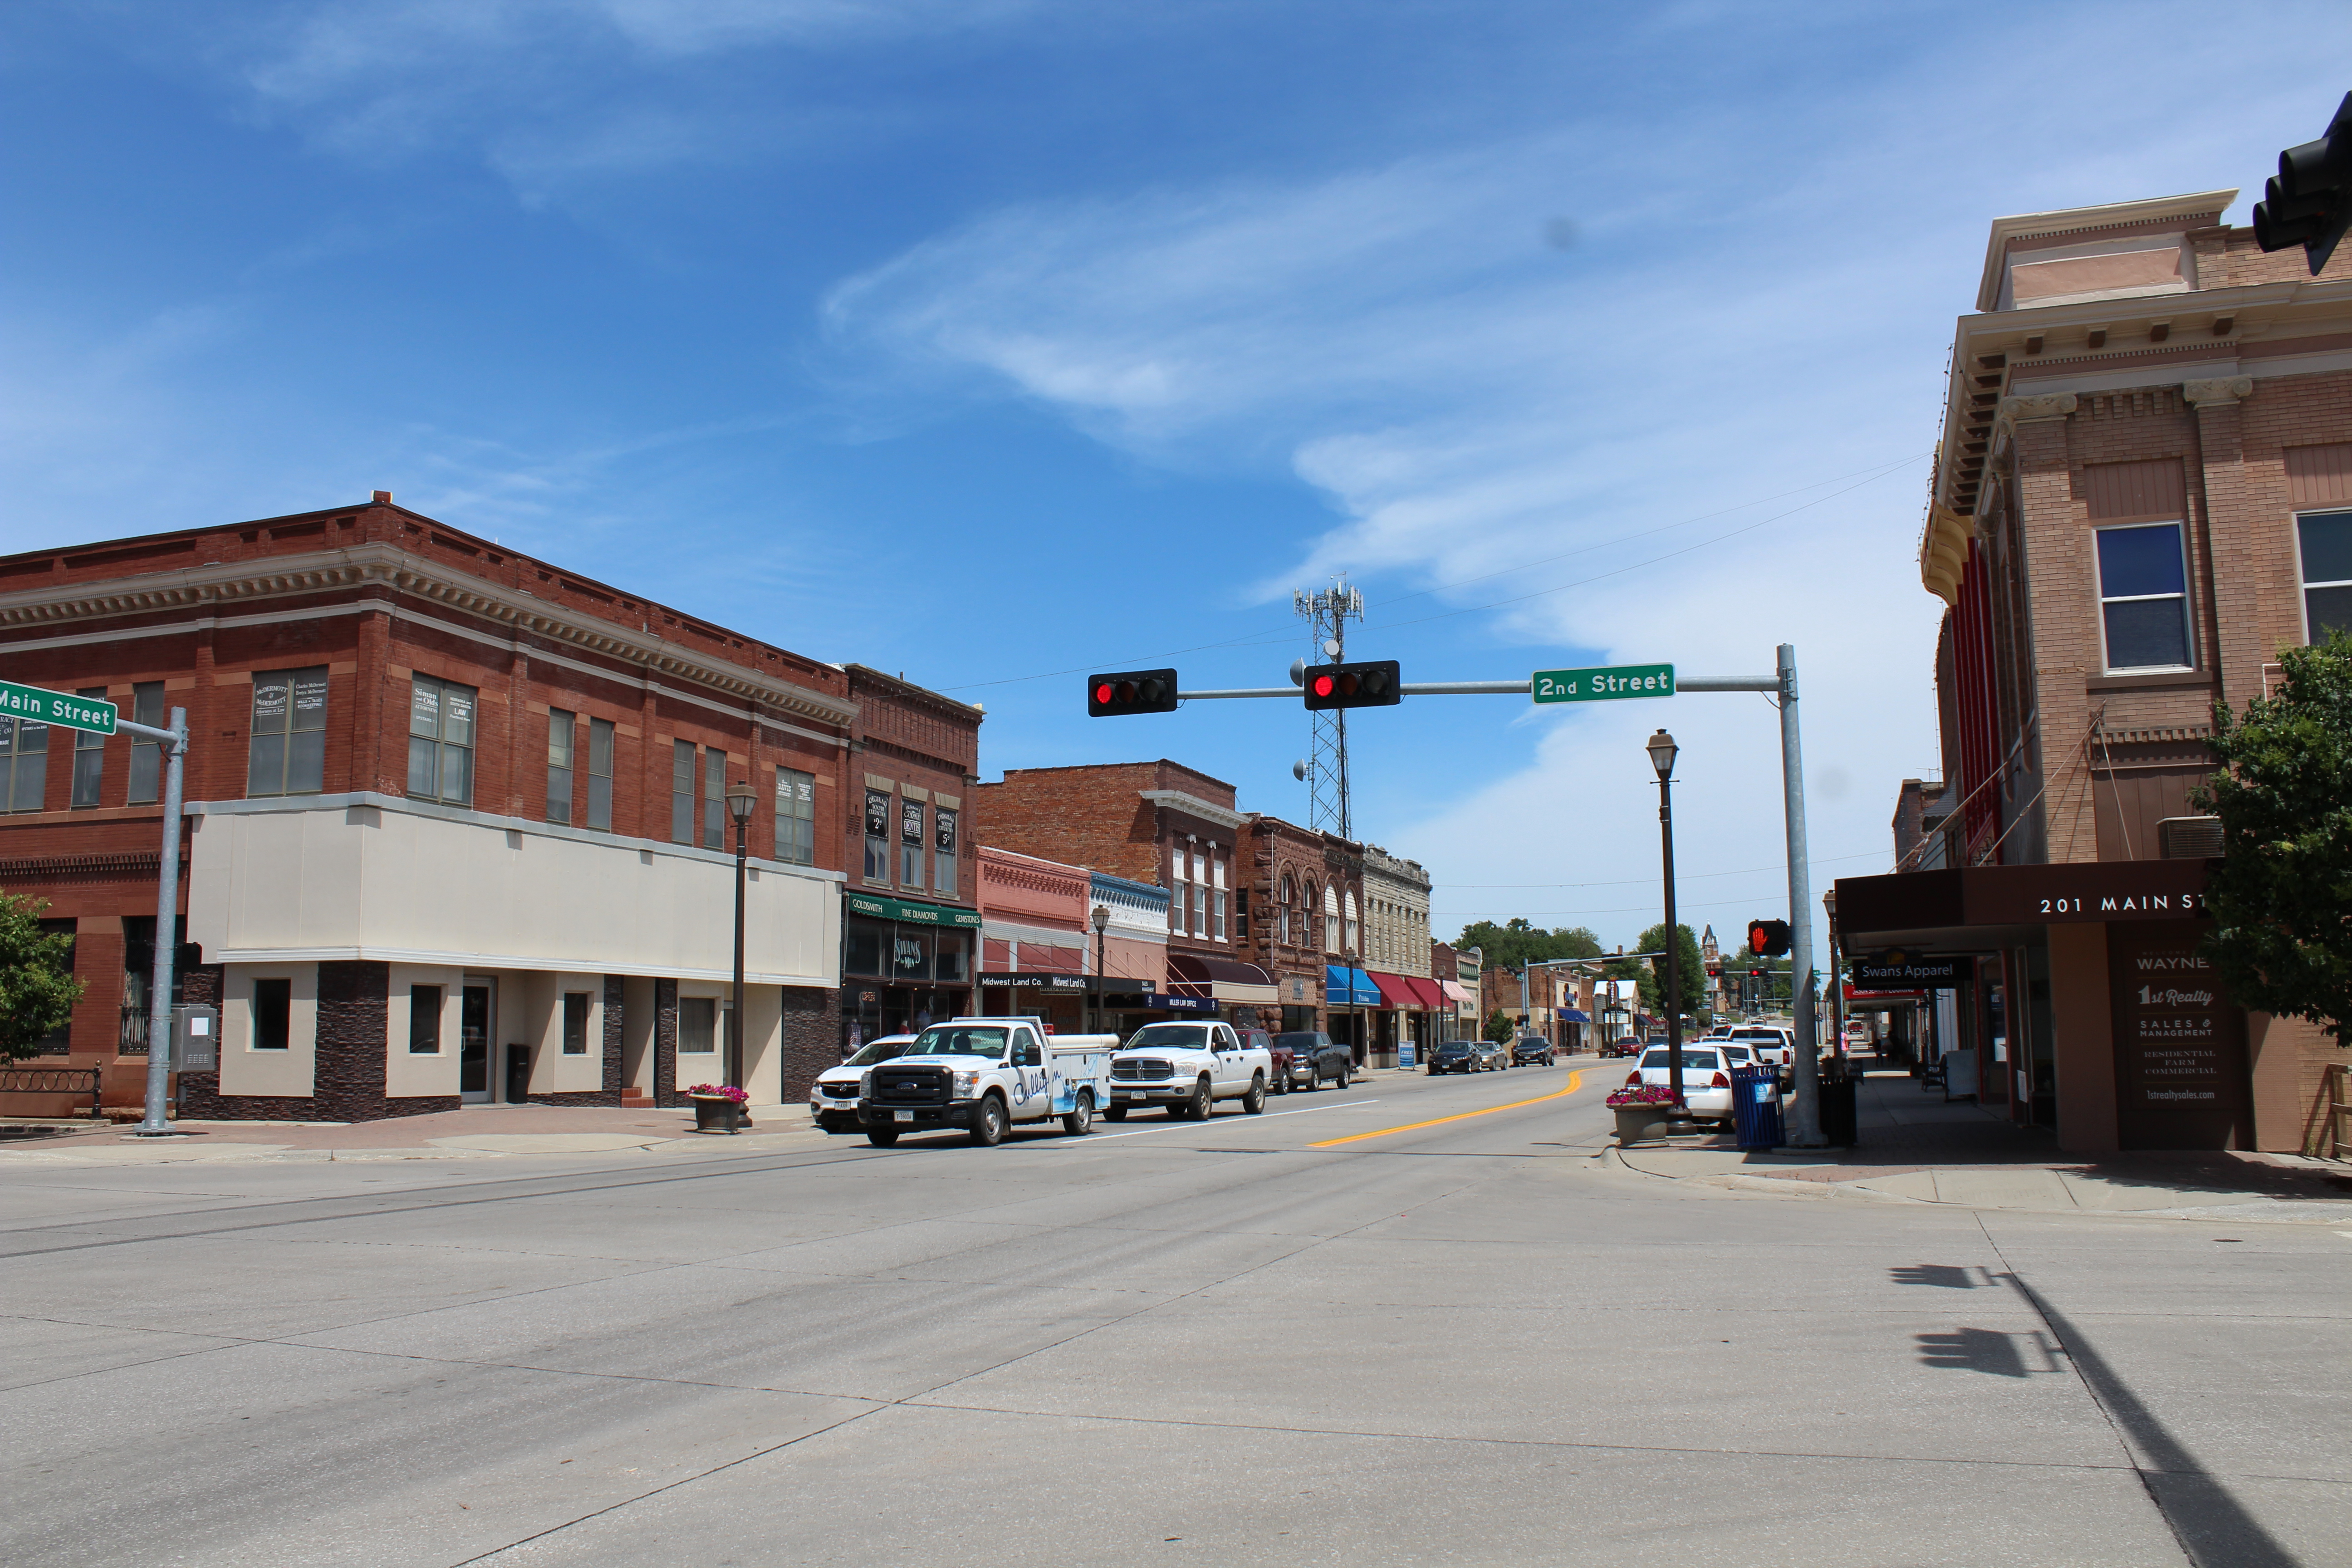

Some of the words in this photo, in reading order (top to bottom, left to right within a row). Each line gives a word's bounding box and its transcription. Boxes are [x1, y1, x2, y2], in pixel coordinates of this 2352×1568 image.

[1539, 678, 1577, 696] 2nd
[1592, 671, 1668, 693] Street
[256, 686, 288, 696] McDERMOTT
[415, 688, 436, 699] Siman
[256, 696, 286, 706] McDERMOTT
[423, 698, 438, 706] Olds
[0, 690, 41, 713] Main
[52, 700, 109, 726] Street
[415, 705, 438, 713] ATTORNEYS
[454, 708, 466, 716] LAW
[778, 783, 791, 792] DAVIS
[868, 795, 887, 807] REGULAR
[904, 820, 921, 833] DENTIST
[853, 899, 883, 913] GOLDSMITH
[2041, 898, 2081, 913] 201
[2101, 896, 2168, 911] MAIN
[902, 908, 911, 918] FINE
[913, 910, 938, 921] DIAMONDS
[955, 914, 980, 924] GEMSTONES
[895, 938, 921, 964] SWANS
[905, 956, 915, 969] MEN
[2136, 957, 2210, 970] WAYNE
[1863, 966, 1901, 976] Swans
[1905, 964, 1953, 978] Apparel
[1053, 977, 1069, 987] Midwest
[1070, 978, 1079, 987] Land
[2138, 985, 2163, 1004] 1st
[2166, 989, 2214, 1006] Realty
[2141, 1020, 2192, 1028] SALES
[2202, 1019, 2211, 1027] &
[1013, 1070, 1062, 1106] Cullign
[2147, 1089, 2215, 1101] 1strealtysales.com
